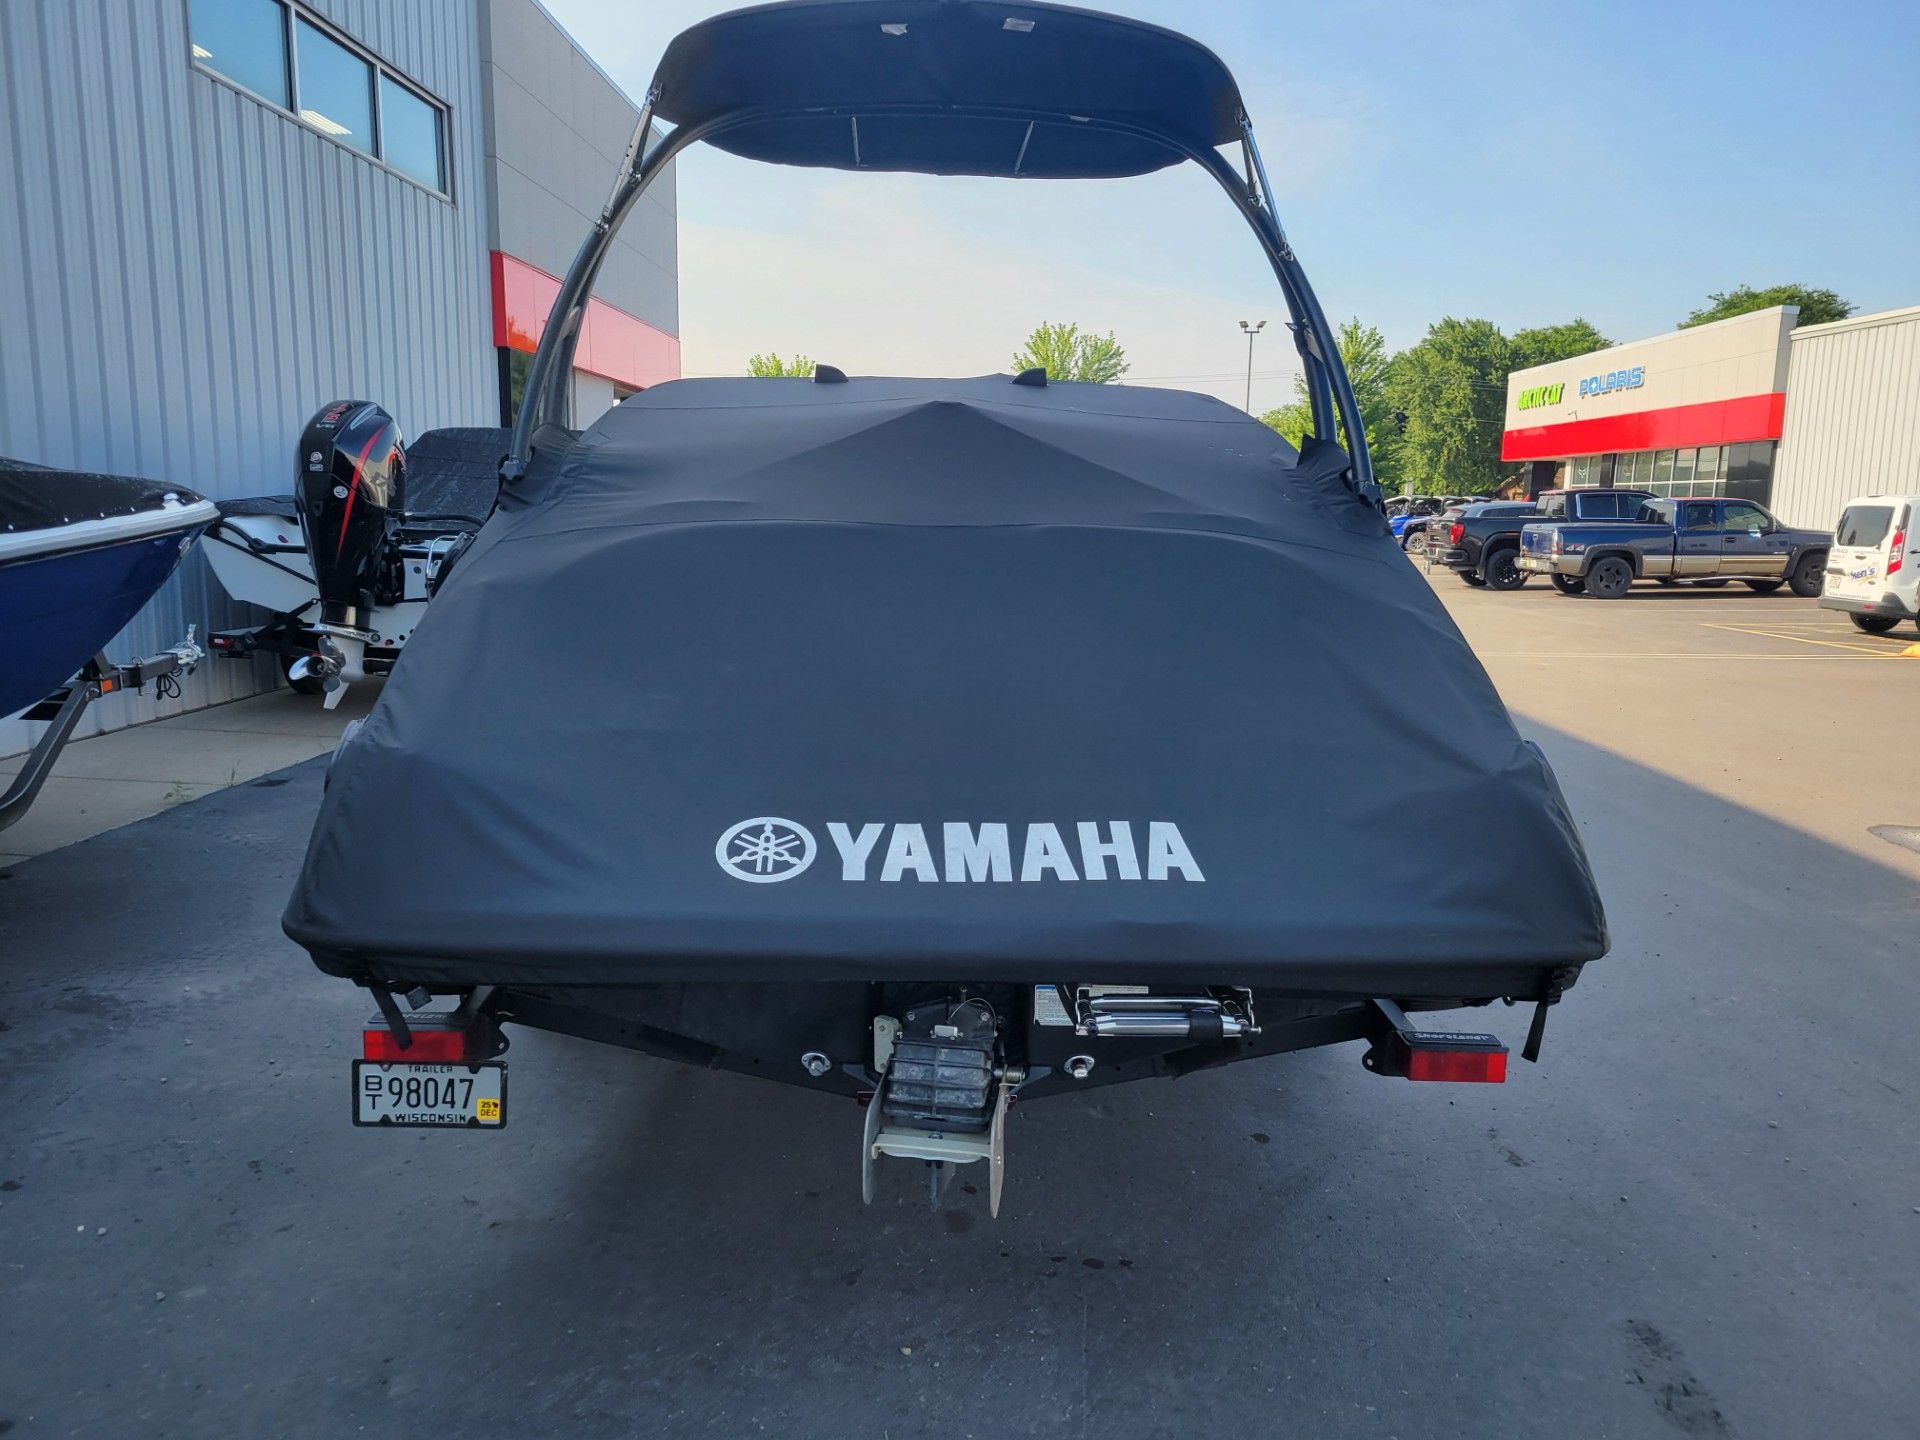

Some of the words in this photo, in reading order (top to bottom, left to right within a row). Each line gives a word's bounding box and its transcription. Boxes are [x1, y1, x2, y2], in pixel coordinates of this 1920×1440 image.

[1579, 366, 1645, 397] POLARIS
[1547, 383, 1565, 406] CAT
[826, 820, 1206, 882] YAMAHA
[408, 1065, 453, 1074] TRAILER
[388, 1077, 474, 1109] 98047
[394, 1113, 467, 1123] WISCONSIN
[480, 1109, 497, 1117] DEC
